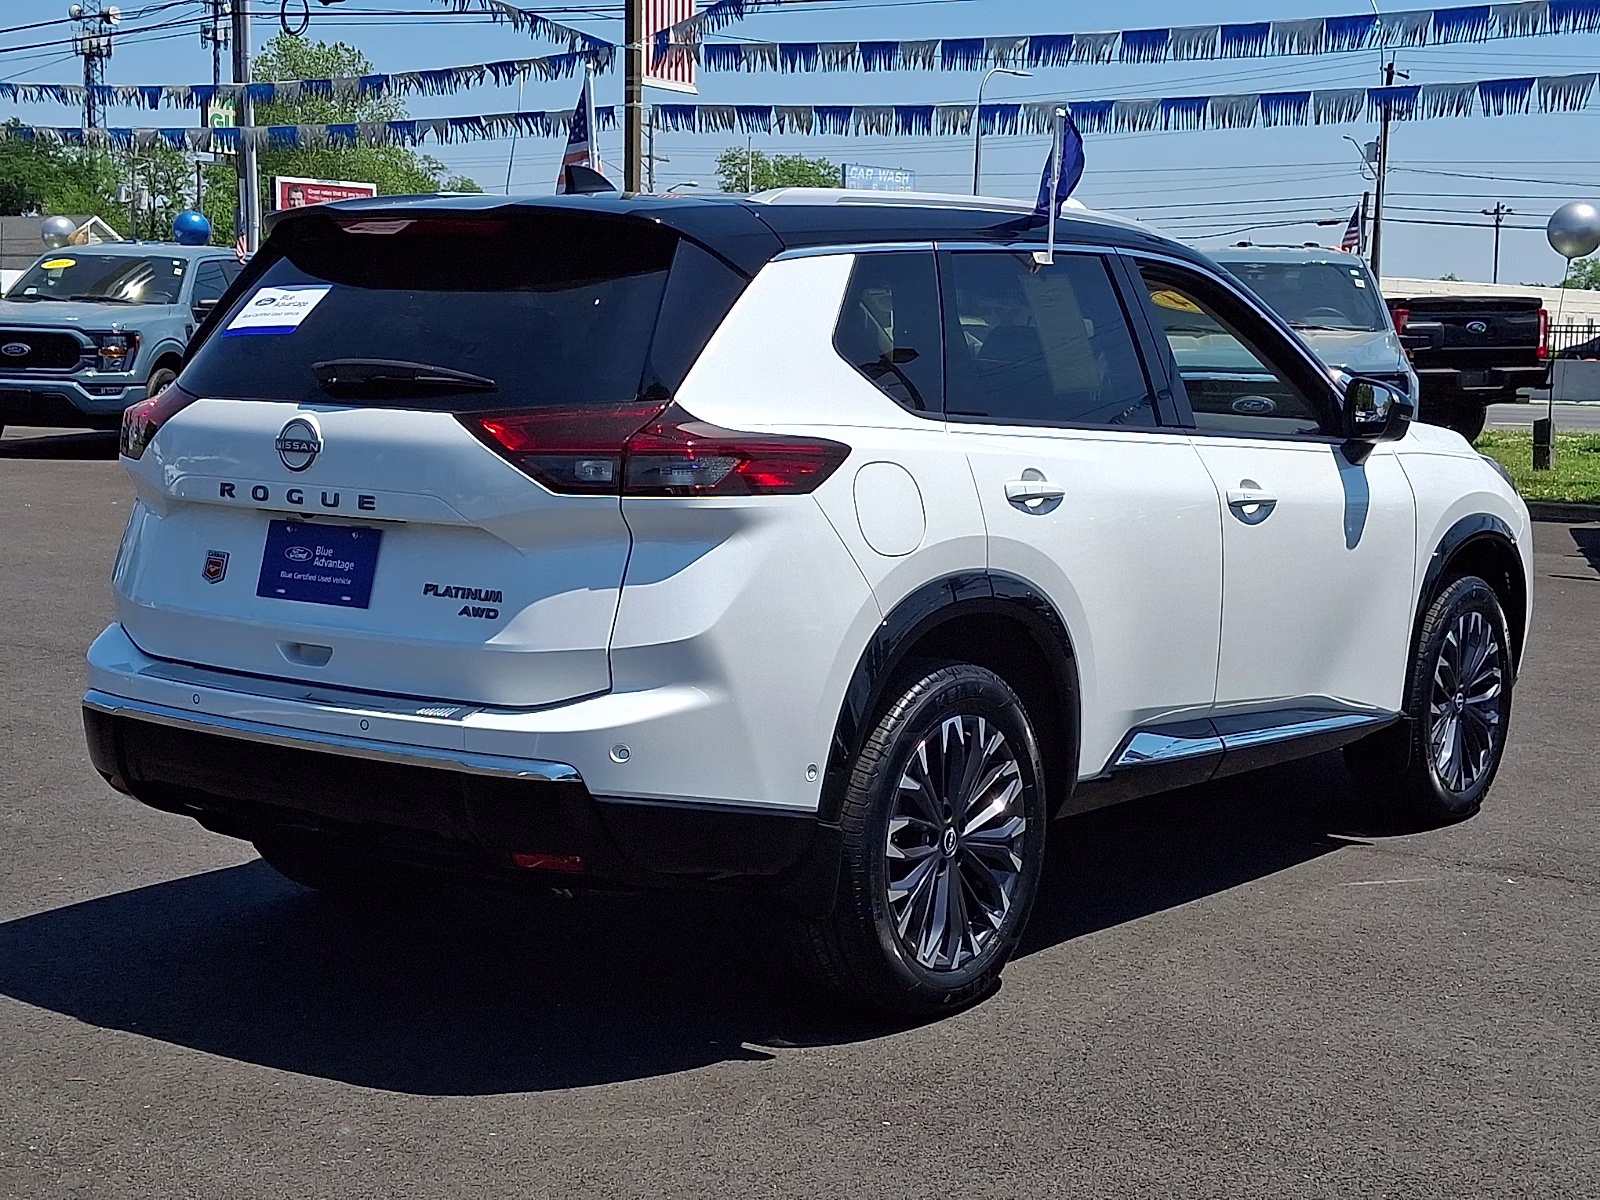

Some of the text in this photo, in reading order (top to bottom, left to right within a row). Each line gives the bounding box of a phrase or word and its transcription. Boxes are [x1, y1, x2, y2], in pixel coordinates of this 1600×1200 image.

[850, 167, 910, 184] CAR WASH
[276, 439, 319, 452] NISSAN
[219, 482, 376, 510] ROGUE
[315, 546, 334, 557] Blue
[313, 557, 355, 571] Advantage
[280, 571, 352, 585] Blue Certified Used Vehicle
[422, 583, 503, 603] PLATINUM
[458, 605, 500, 620] AWD
